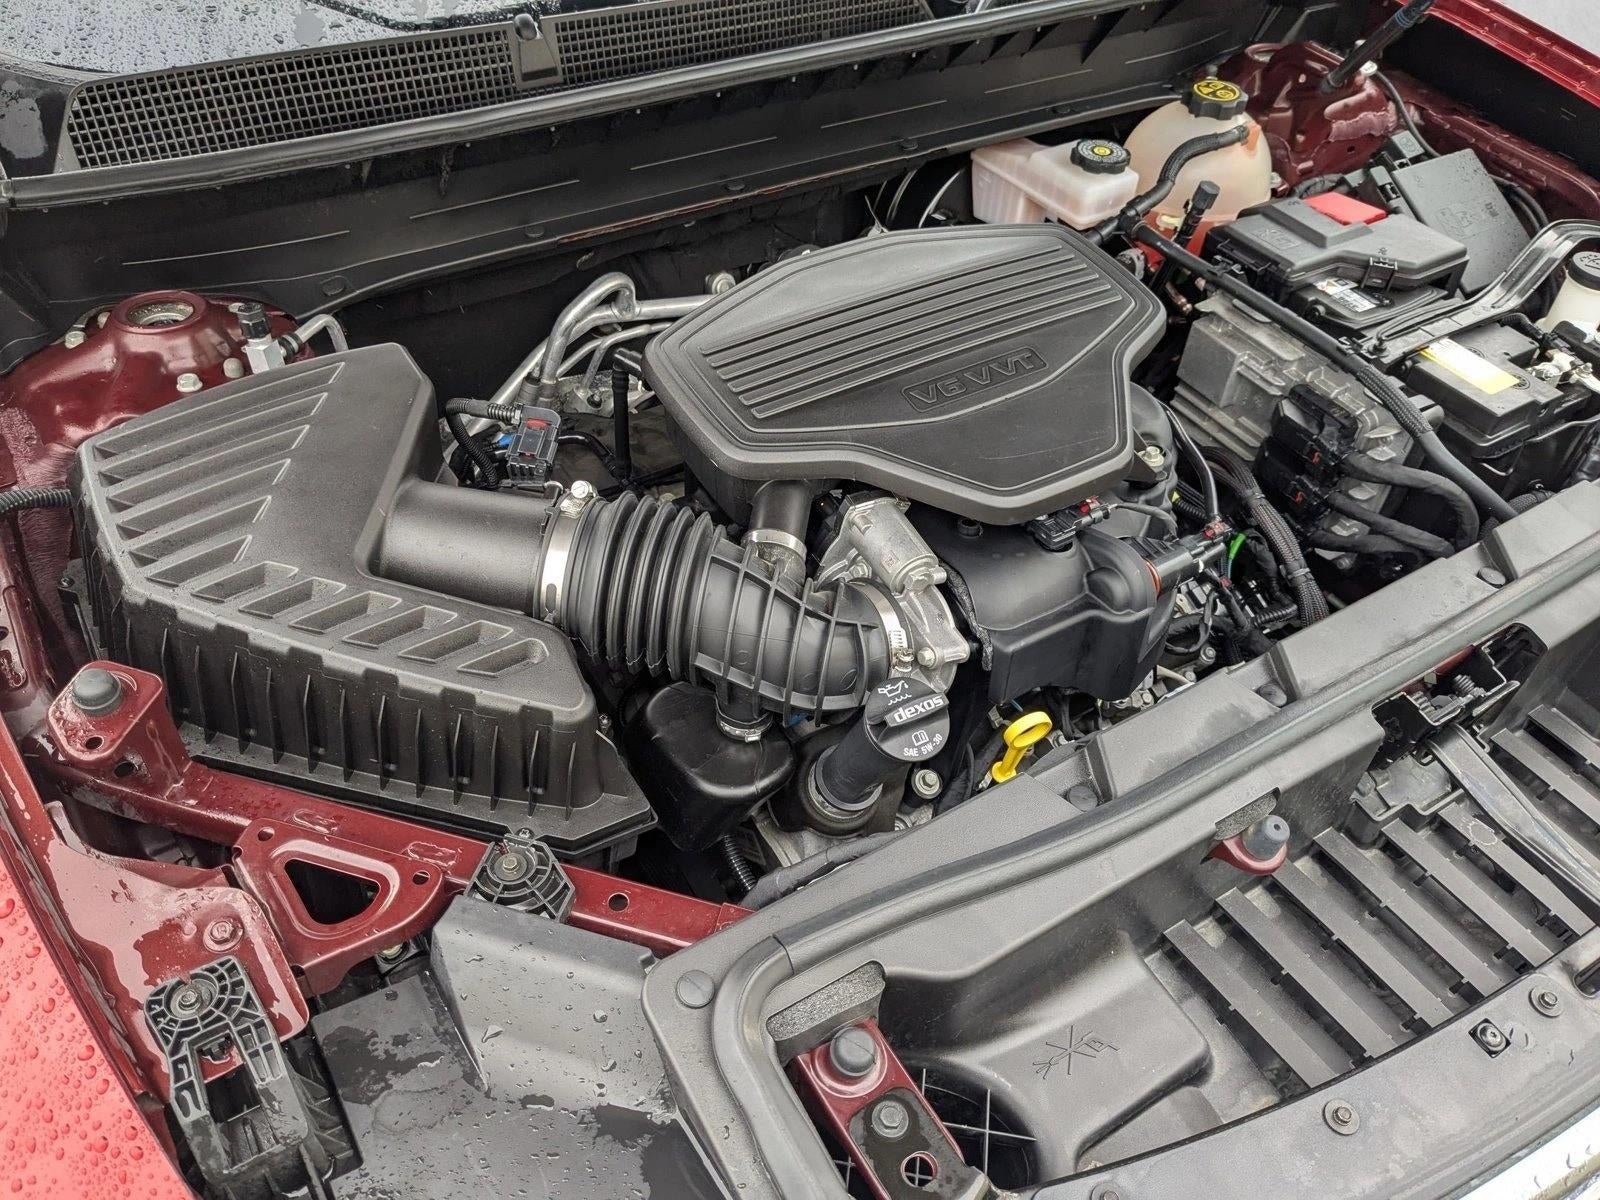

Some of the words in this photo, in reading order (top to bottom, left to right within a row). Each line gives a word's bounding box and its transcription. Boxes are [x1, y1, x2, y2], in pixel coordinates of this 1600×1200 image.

[909, 378, 967, 404] V6
[964, 351, 1035, 386] VVT
[893, 694, 944, 723] dexos
[903, 747, 919, 757] SAE
[921, 733, 943, 755] 5W-30
